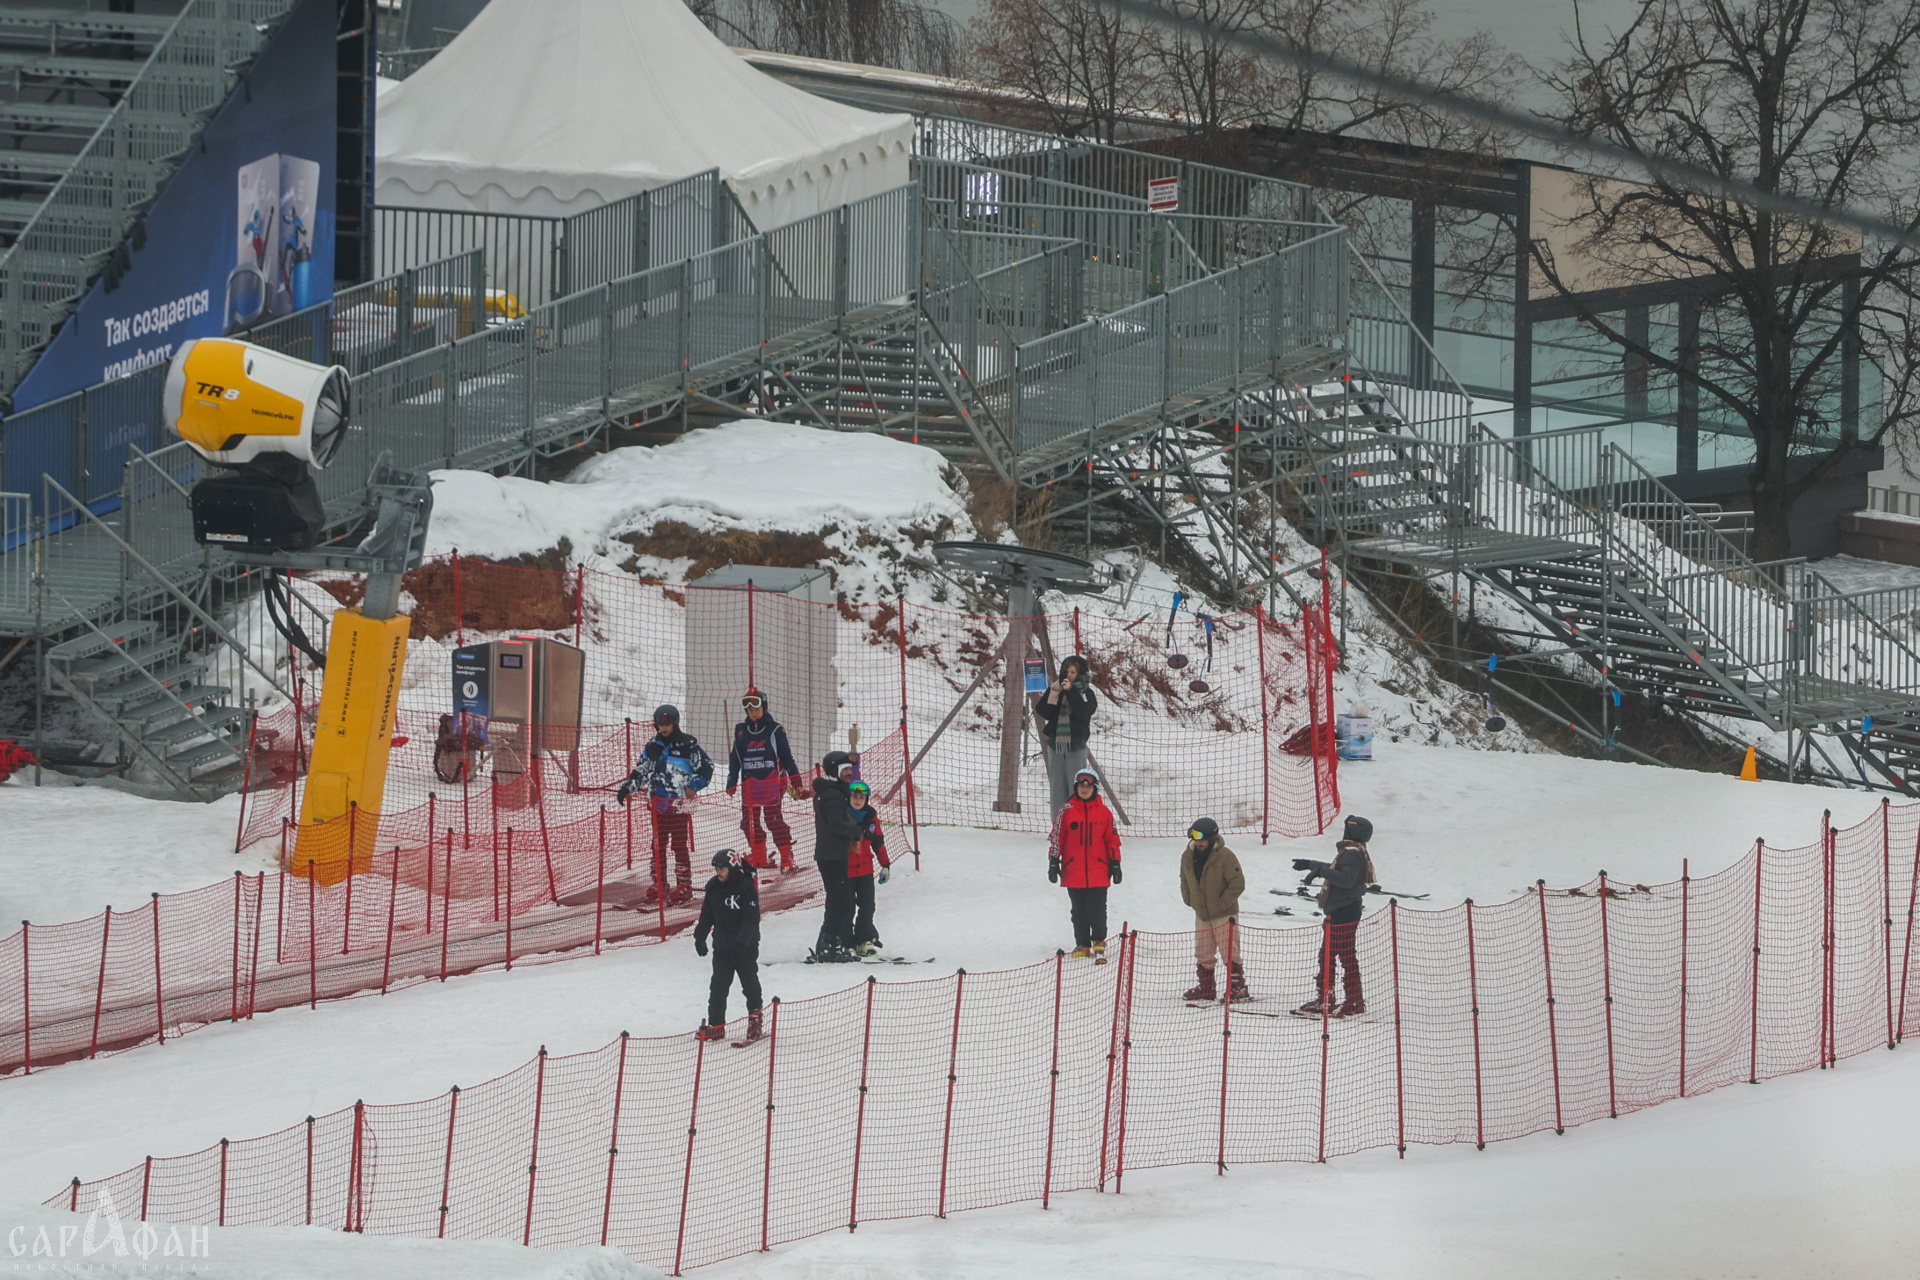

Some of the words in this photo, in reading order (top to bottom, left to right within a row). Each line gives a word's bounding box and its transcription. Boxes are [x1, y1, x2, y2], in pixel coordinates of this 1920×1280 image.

[104, 318, 131, 347] Так
[133, 289, 209, 338] создается
[104, 343, 172, 382] комфорт
[197, 382, 240, 400] TR8
[341, 630, 358, 722] WWW.TECHNOALPIN.COM
[378, 635, 401, 740] TECHNOALPIN
[724, 895, 741, 909] CK
